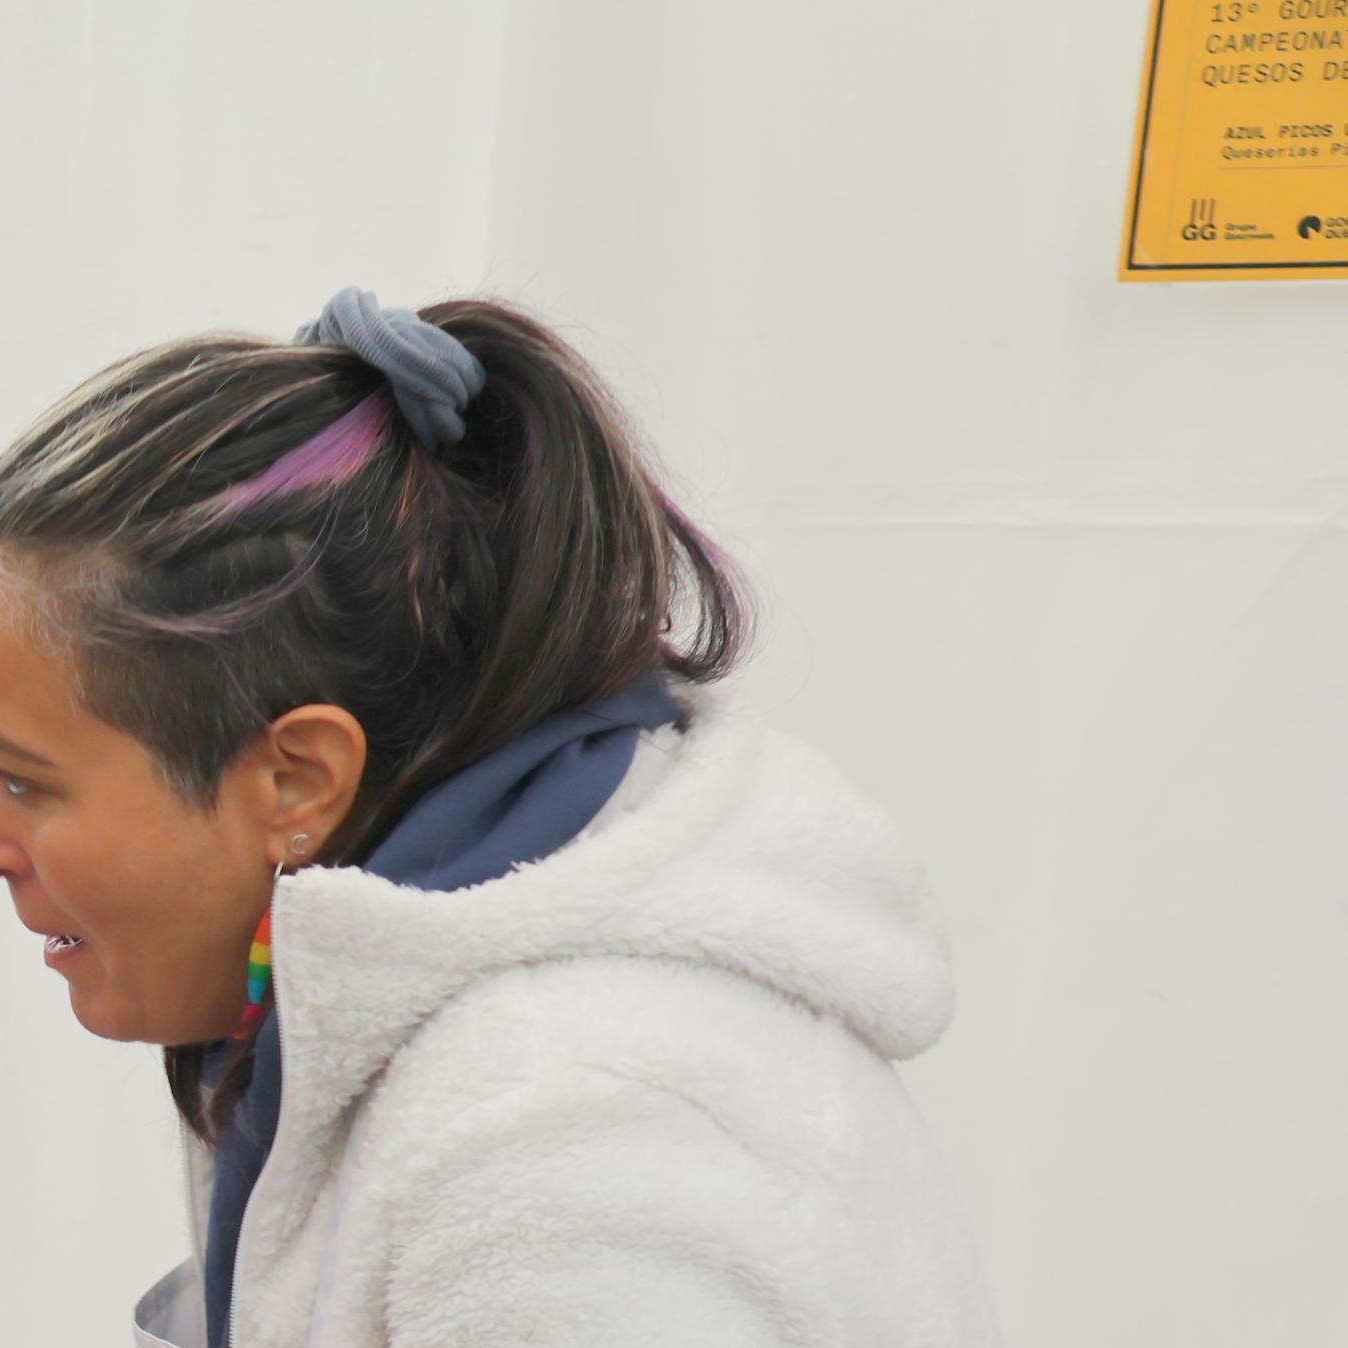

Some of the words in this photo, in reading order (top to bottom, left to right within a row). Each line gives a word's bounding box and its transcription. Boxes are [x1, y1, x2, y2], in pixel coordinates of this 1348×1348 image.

[1206, 30, 1348, 54] CAMPEONA
[1202, 62, 1305, 88] QUESOS
[1224, 125, 1266, 140] AZUL
[1279, 123, 1334, 138] PICOS
